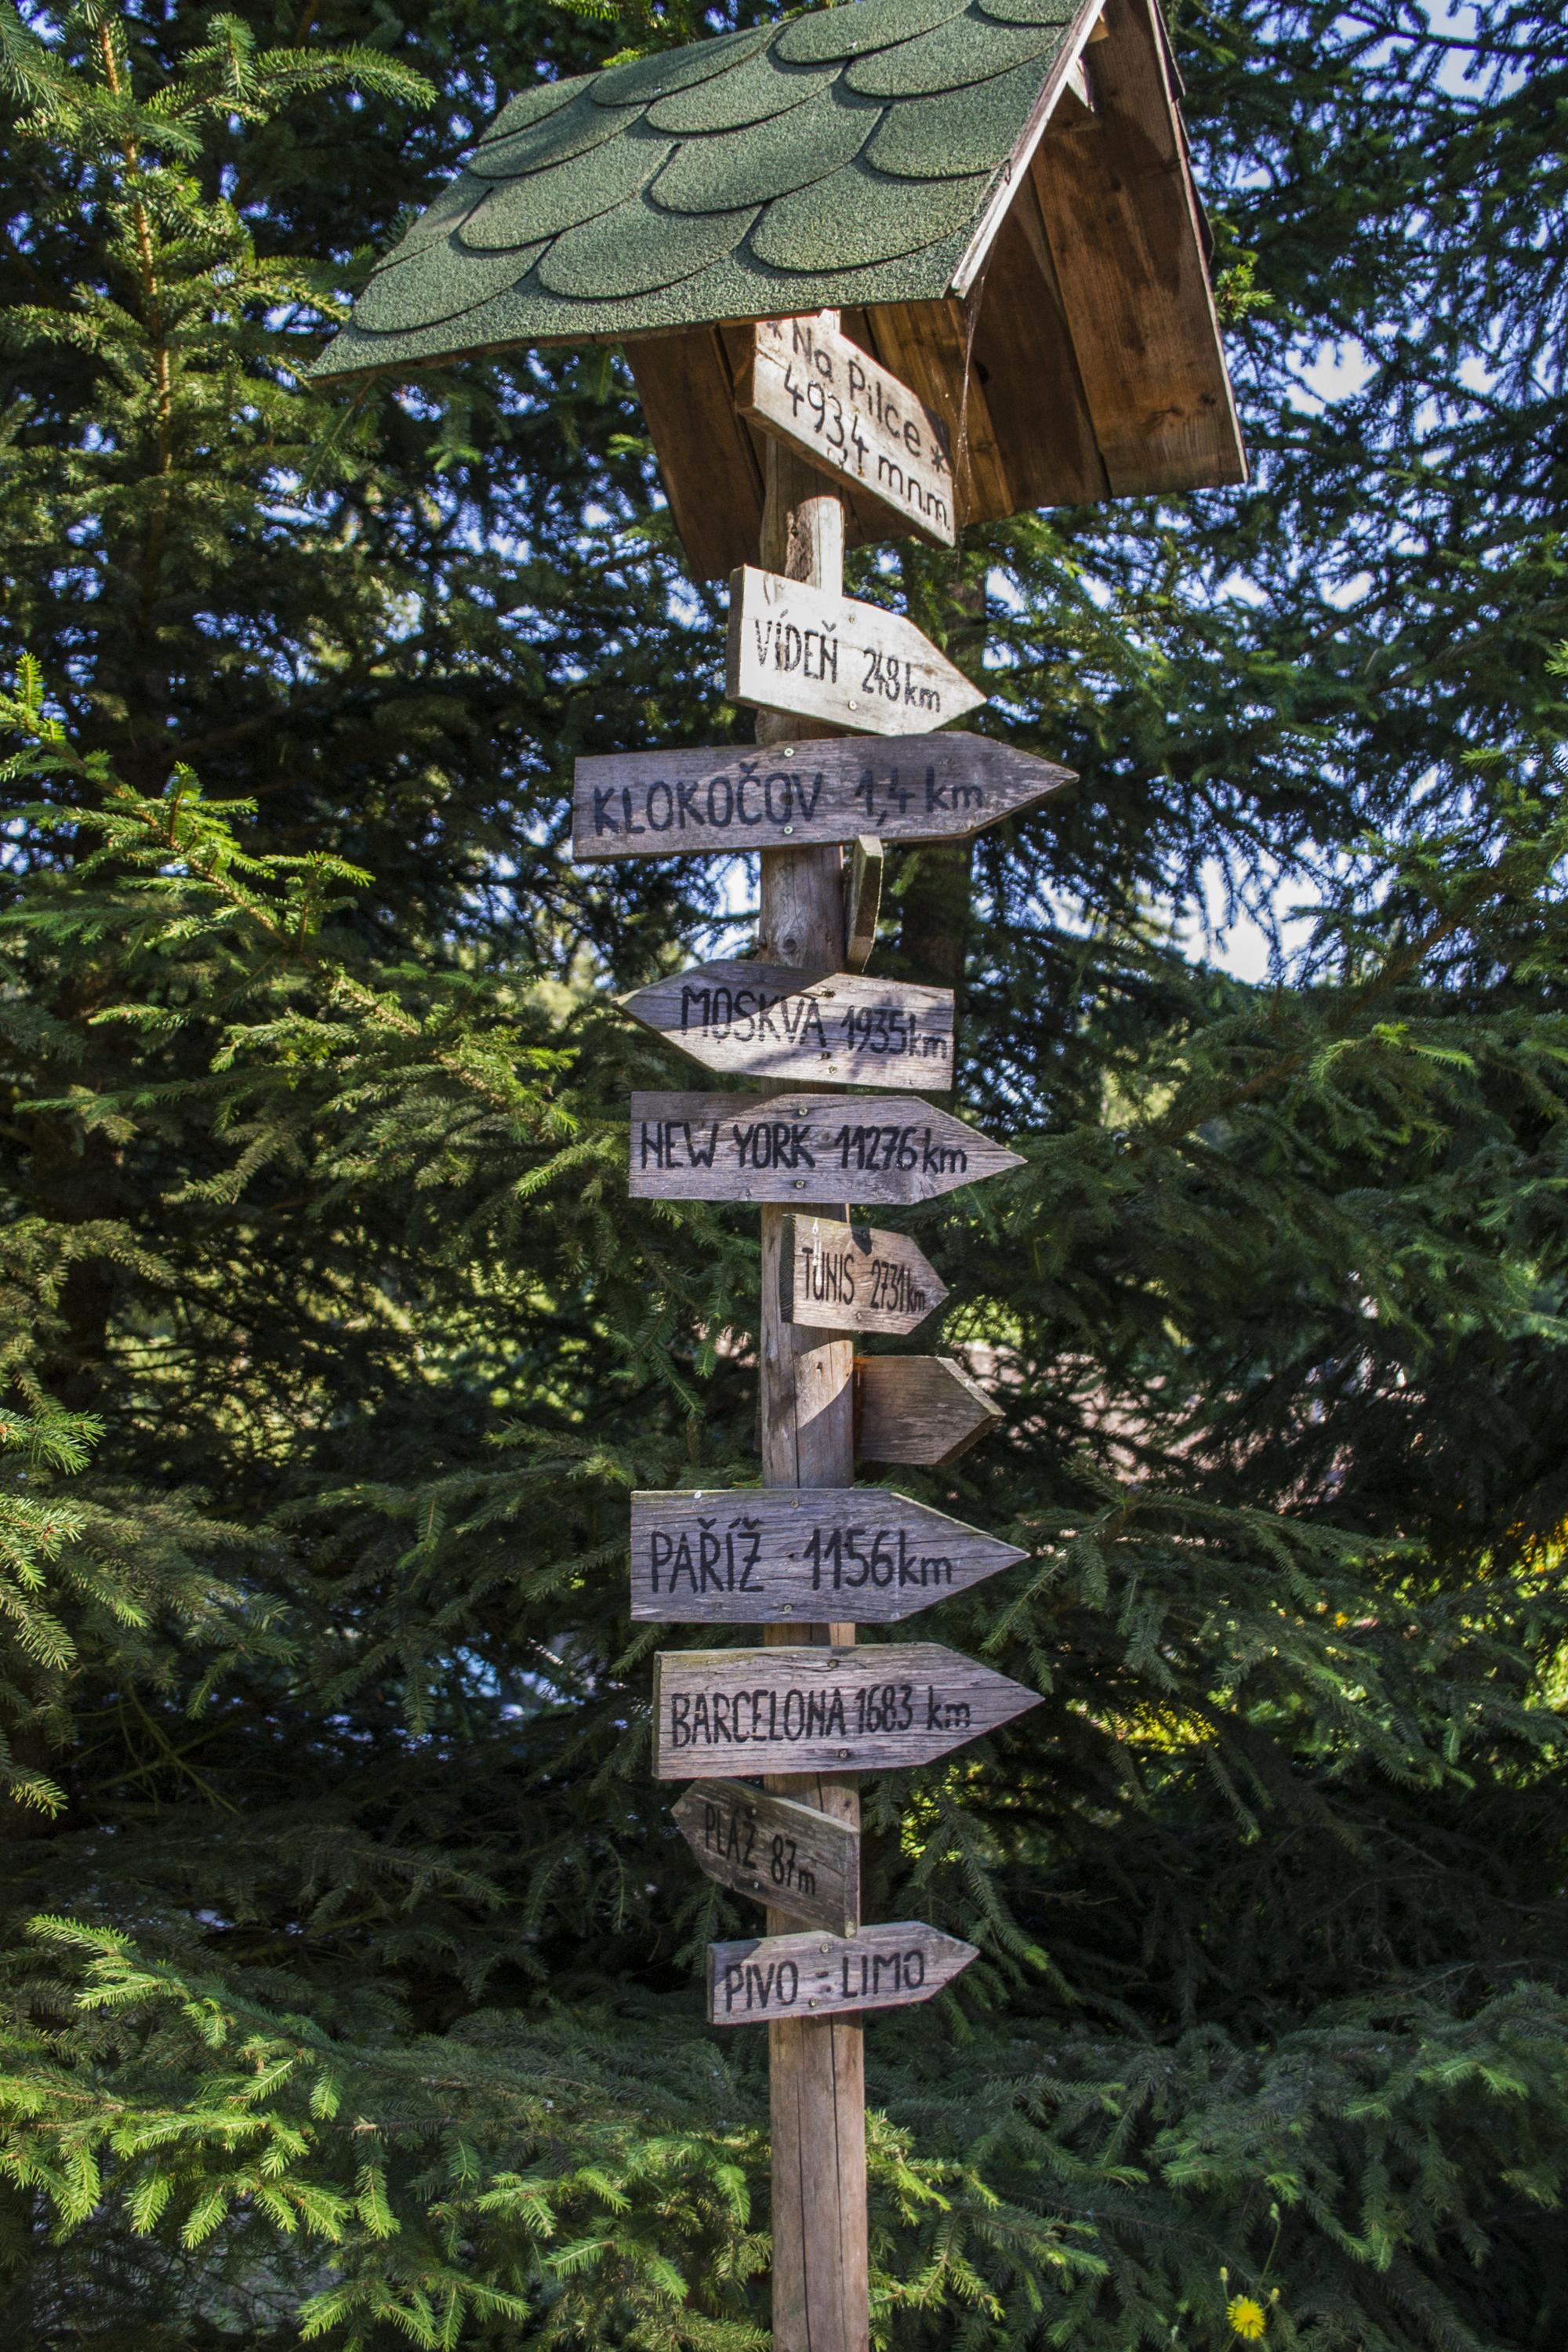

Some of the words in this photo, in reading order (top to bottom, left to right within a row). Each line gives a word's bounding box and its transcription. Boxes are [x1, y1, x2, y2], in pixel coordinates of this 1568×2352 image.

[791, 318, 835, 384] Na
[848, 359, 922, 458] Pilce
[754, 609, 838, 684] VÍDEŇ
[593, 762, 822, 836] KLOKOČOV
[855, 767, 917, 827] 1,4
[926, 766, 985, 813] km
[681, 985, 827, 1049] MOSKVA
[640, 1122, 719, 1170] NEW
[731, 1122, 816, 1170] YORK
[801, 1247, 855, 1306] TUNIS
[650, 1517, 765, 1593] PAŘÍŽ
[671, 1688, 847, 1748] BARCELONA
[855, 1684, 913, 1735] 1683
[927, 1686, 971, 1731] km
[724, 1960, 799, 2013] PIVO
[841, 1949, 925, 1998] LIMO
